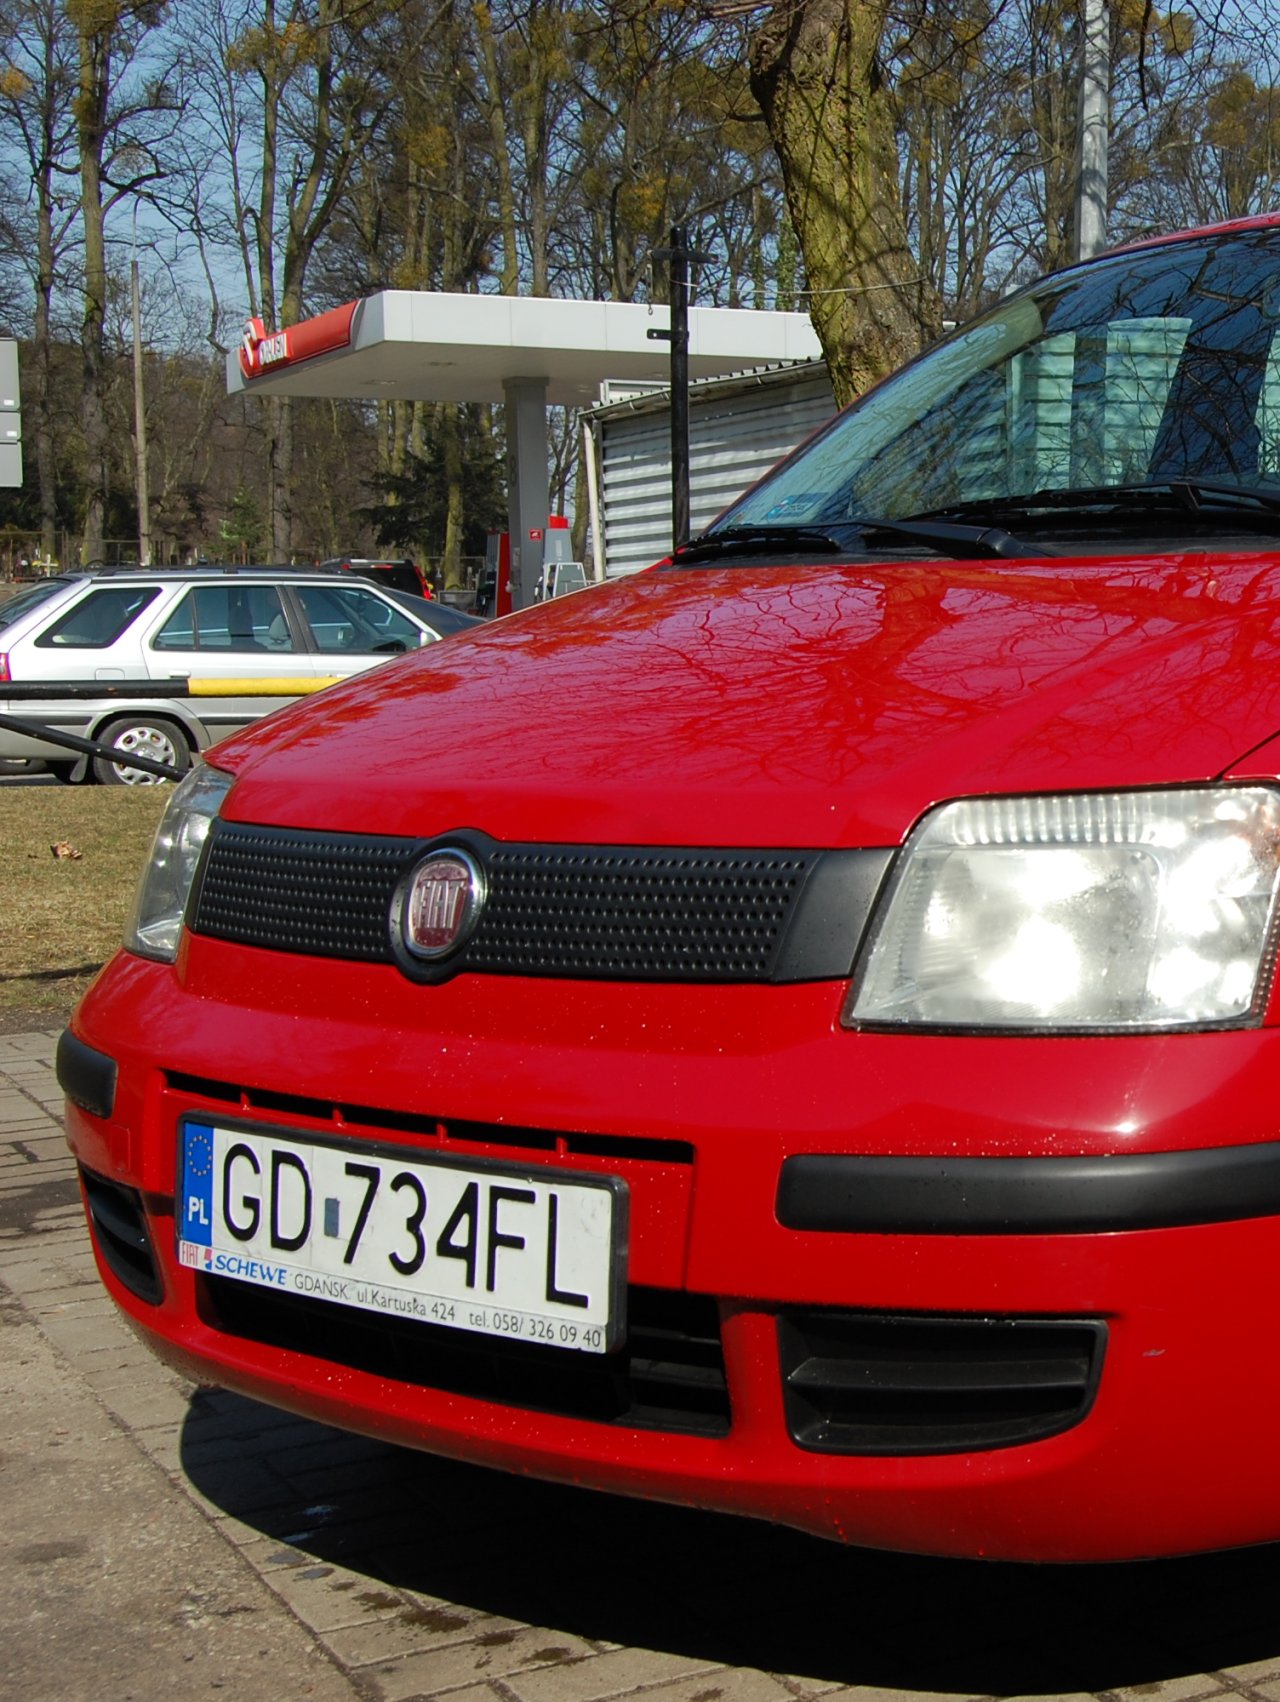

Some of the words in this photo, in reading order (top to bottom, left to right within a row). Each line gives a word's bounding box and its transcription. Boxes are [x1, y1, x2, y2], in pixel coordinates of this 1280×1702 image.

[415, 880, 466, 929] FIAT
[188, 1195, 209, 1226] PL
[222, 1143, 312, 1252] GD
[343, 1161, 589, 1309] 734FL
[181, 1242, 199, 1267] FIAT
[215, 1254, 288, 1286] SCHEWE
[431, 1301, 456, 1322] 424
[469, 1311, 491, 1329] tel.
[493, 1312, 524, 1335] 058/
[529, 1317, 555, 1341] 326
[559, 1323, 578, 1344] 09
[582, 1329, 602, 1348] 40
